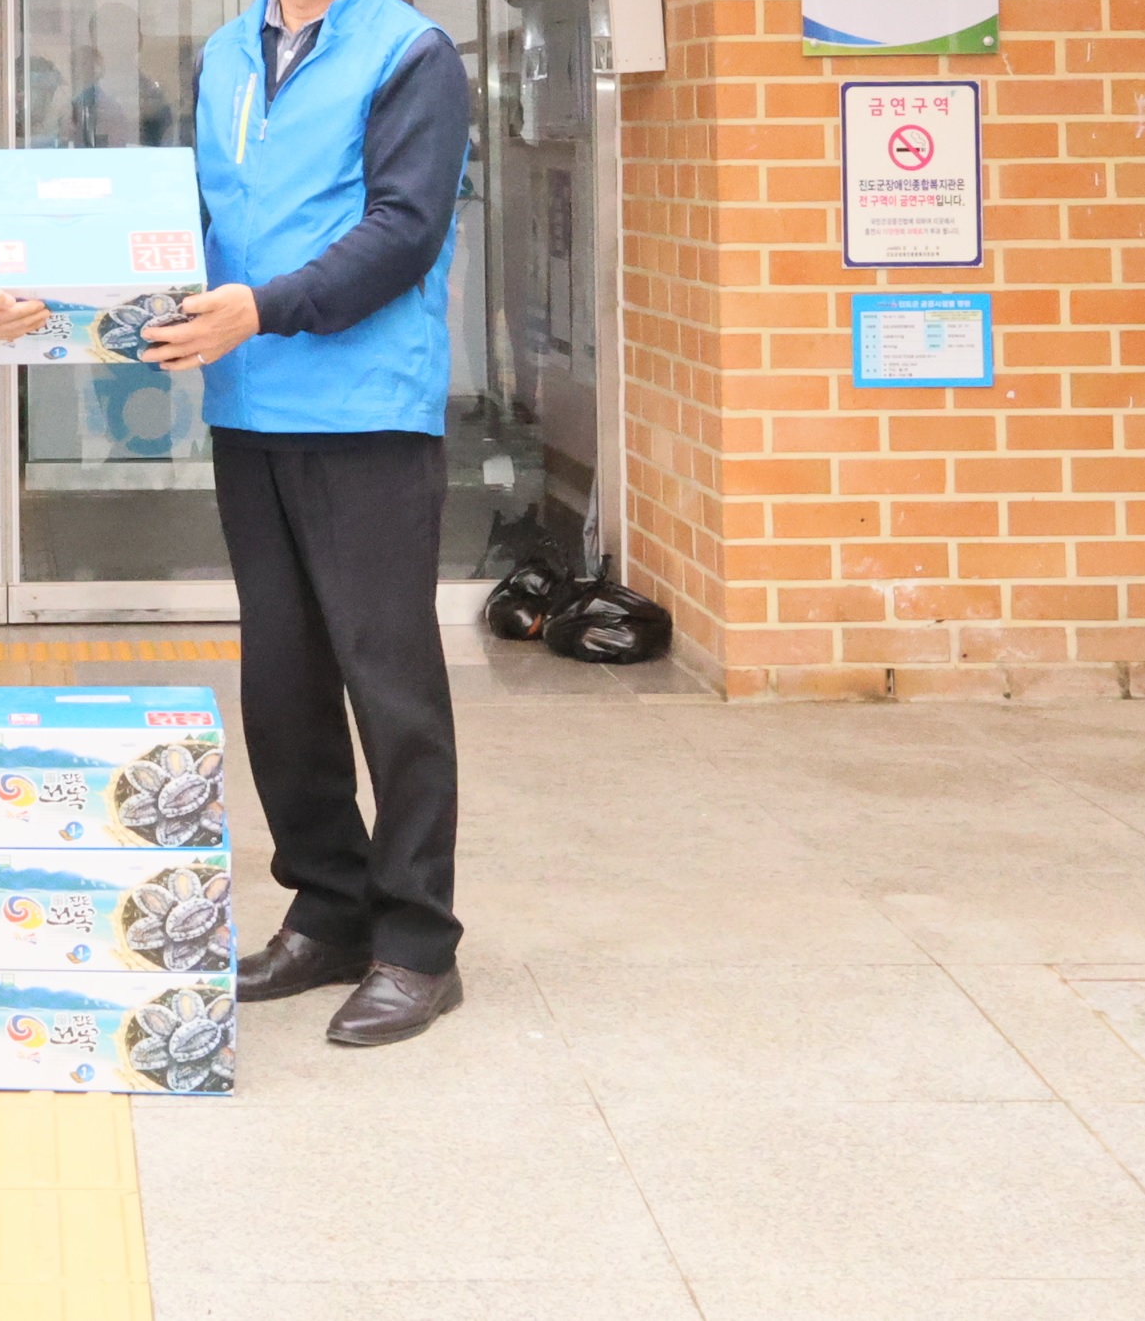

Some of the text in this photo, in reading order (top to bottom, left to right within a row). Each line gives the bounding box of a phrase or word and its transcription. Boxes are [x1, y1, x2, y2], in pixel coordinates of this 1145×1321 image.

[869, 97, 949, 116] 금연구역
[859, 179, 965, 191] 진도군장애인종합복지관은
[859, 195, 965, 207] 전 구역이 금연구역입니다.
[136, 246, 192, 269] 긴급
[62, 773, 82, 784] 진도
[69, 896, 90, 907] 진도
[73, 1016, 94, 1026] 진도
